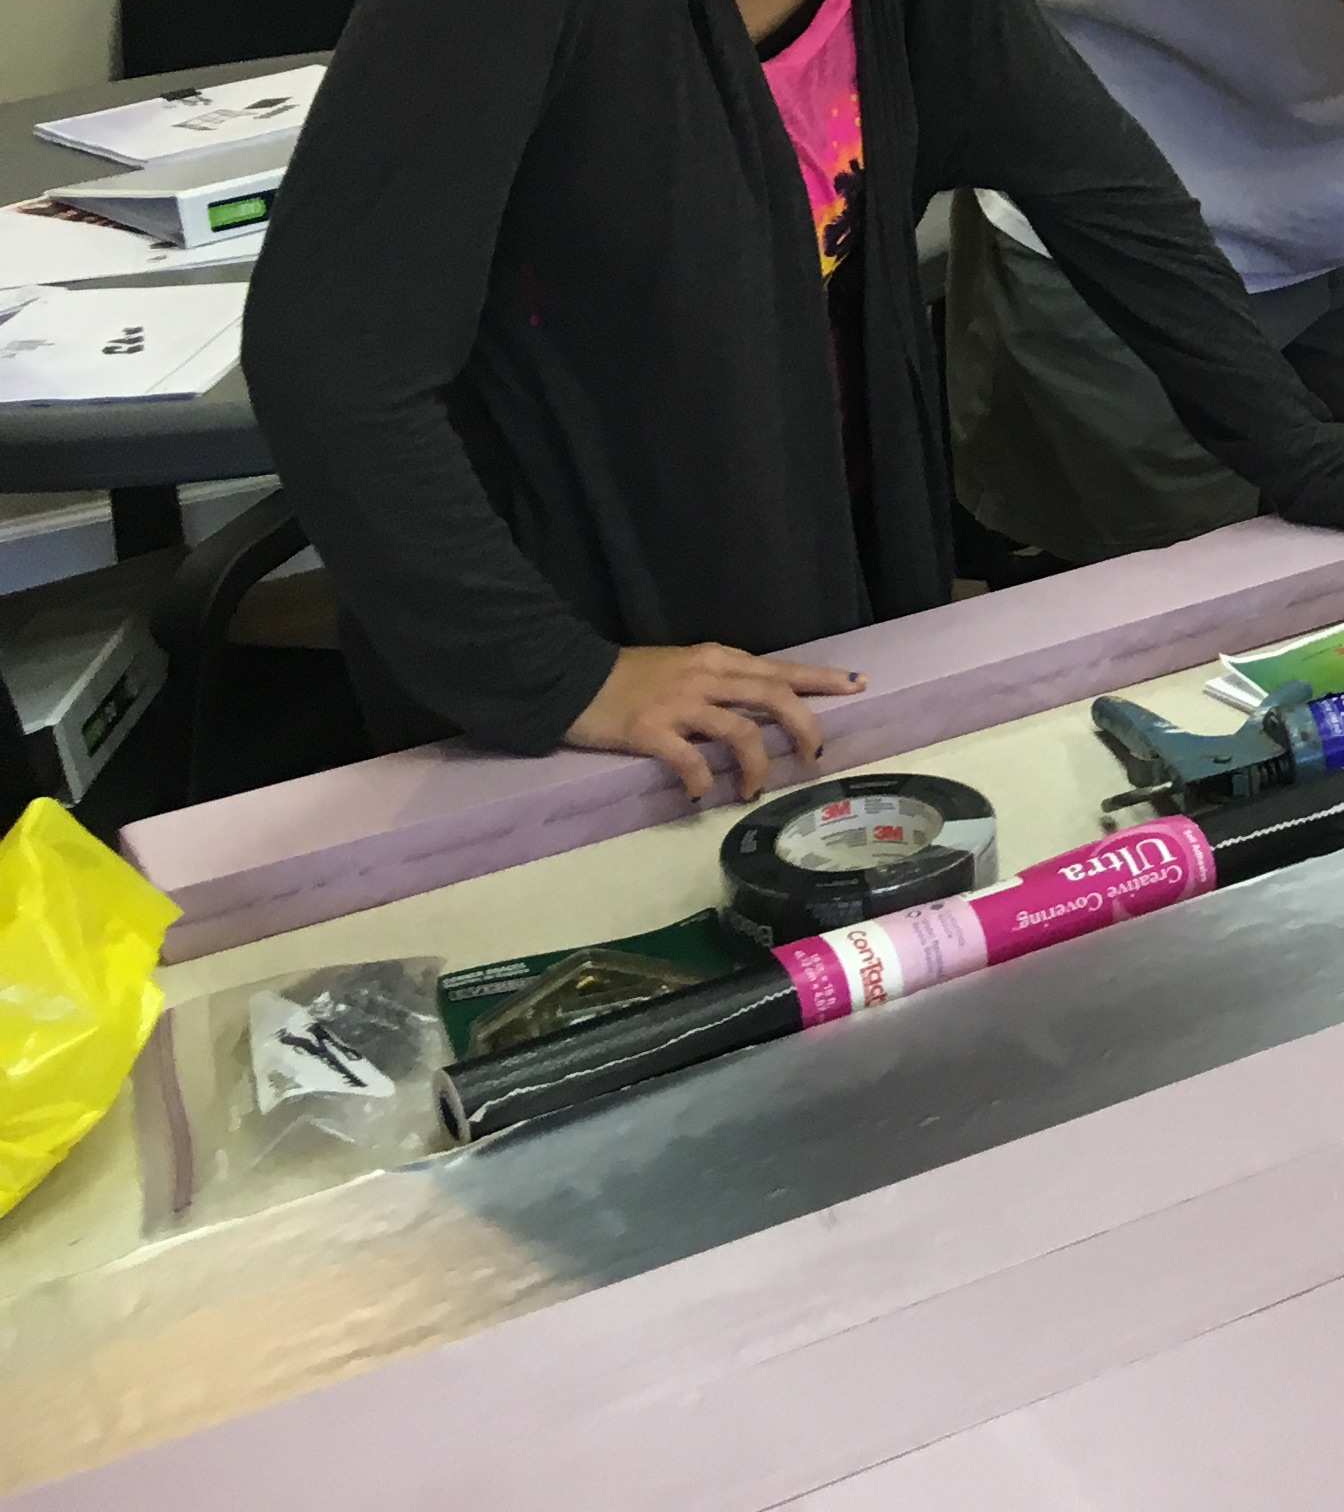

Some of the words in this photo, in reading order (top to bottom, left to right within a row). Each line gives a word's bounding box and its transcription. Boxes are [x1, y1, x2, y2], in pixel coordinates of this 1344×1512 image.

[821, 800, 850, 821] 3M
[873, 825, 903, 840] 3M
[1059, 838, 1178, 881] Ultra
[1107, 865, 1184, 898] Creative
